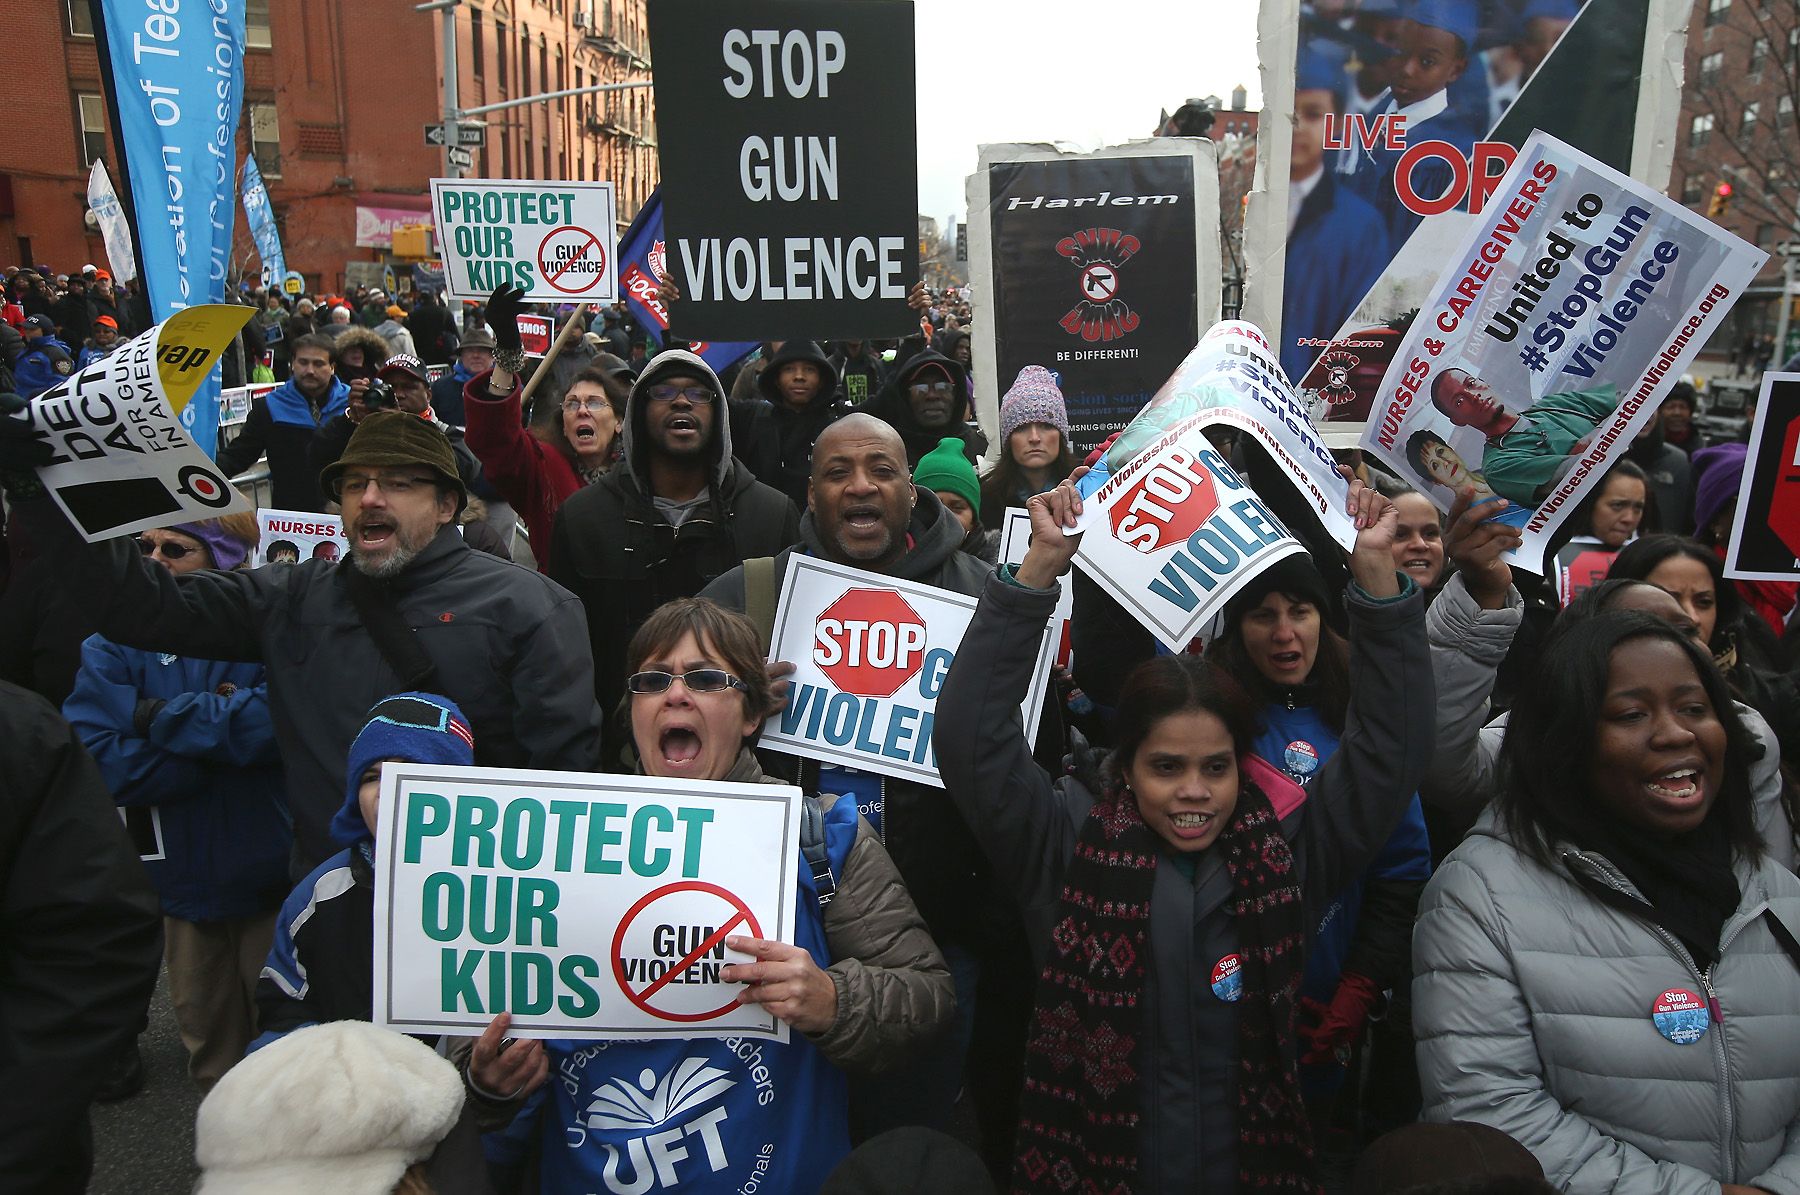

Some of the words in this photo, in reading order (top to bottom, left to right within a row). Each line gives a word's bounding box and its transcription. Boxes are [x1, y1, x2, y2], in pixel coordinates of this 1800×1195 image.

[722, 29, 846, 98] STOP
[140, 79, 181, 126] of
[1323, 113, 1408, 151] LIVE
[740, 135, 839, 201] GUN
[1394, 139, 1519, 216] OR
[442, 191, 575, 225] PROTECT
[1007, 192, 1179, 211] Harlem
[454, 226, 514, 258] OUR
[555, 244, 588, 261] GUN
[466, 260, 535, 292] KIDS
[542, 260, 602, 274] VIOLENCE
[678, 236, 905, 301] VIOLENCE
[1484, 231, 1577, 343] United
[1561, 193, 1603, 230] to
[1519, 205, 1652, 372] #StopGun
[1377, 356, 1430, 453] NURSES
[1423, 336, 1445, 357] &
[1436, 159, 1559, 333] CAREGIVERS
[1562, 240, 1679, 379] Violence
[1056, 351, 1071, 362] BE
[1075, 349, 1139, 361] DIFFERENT!
[1297, 338, 1384, 347] Harlem
[115, 348, 135, 400] GUN
[1226, 343, 1302, 402] Unite
[77, 368, 147, 454] ACT
[128, 408, 168, 452] FOR
[1067, 422, 1130, 432] MSNUG@GMA
[1527, 283, 1730, 534] NYVoicesAgainstGunViolence.org
[159, 427, 189, 449] IN
[1116, 448, 1204, 554] STOP
[268, 520, 336, 537] NURSES
[813, 618, 927, 669] STOP
[403, 792, 715, 879] PROTECT
[421, 871, 560, 948] OUR
[653, 924, 727, 960] GUN
[1219, 957, 1238, 972] Stop
[441, 947, 600, 1018] KIDS
[620, 957, 757, 985] VIOLEN
[1658, 1004, 1672, 1012] Gun
[1672, 1001, 1699, 1011] Violence
[1664, 992, 1688, 1004] Stop
[601, 1105, 729, 1195] UFT
